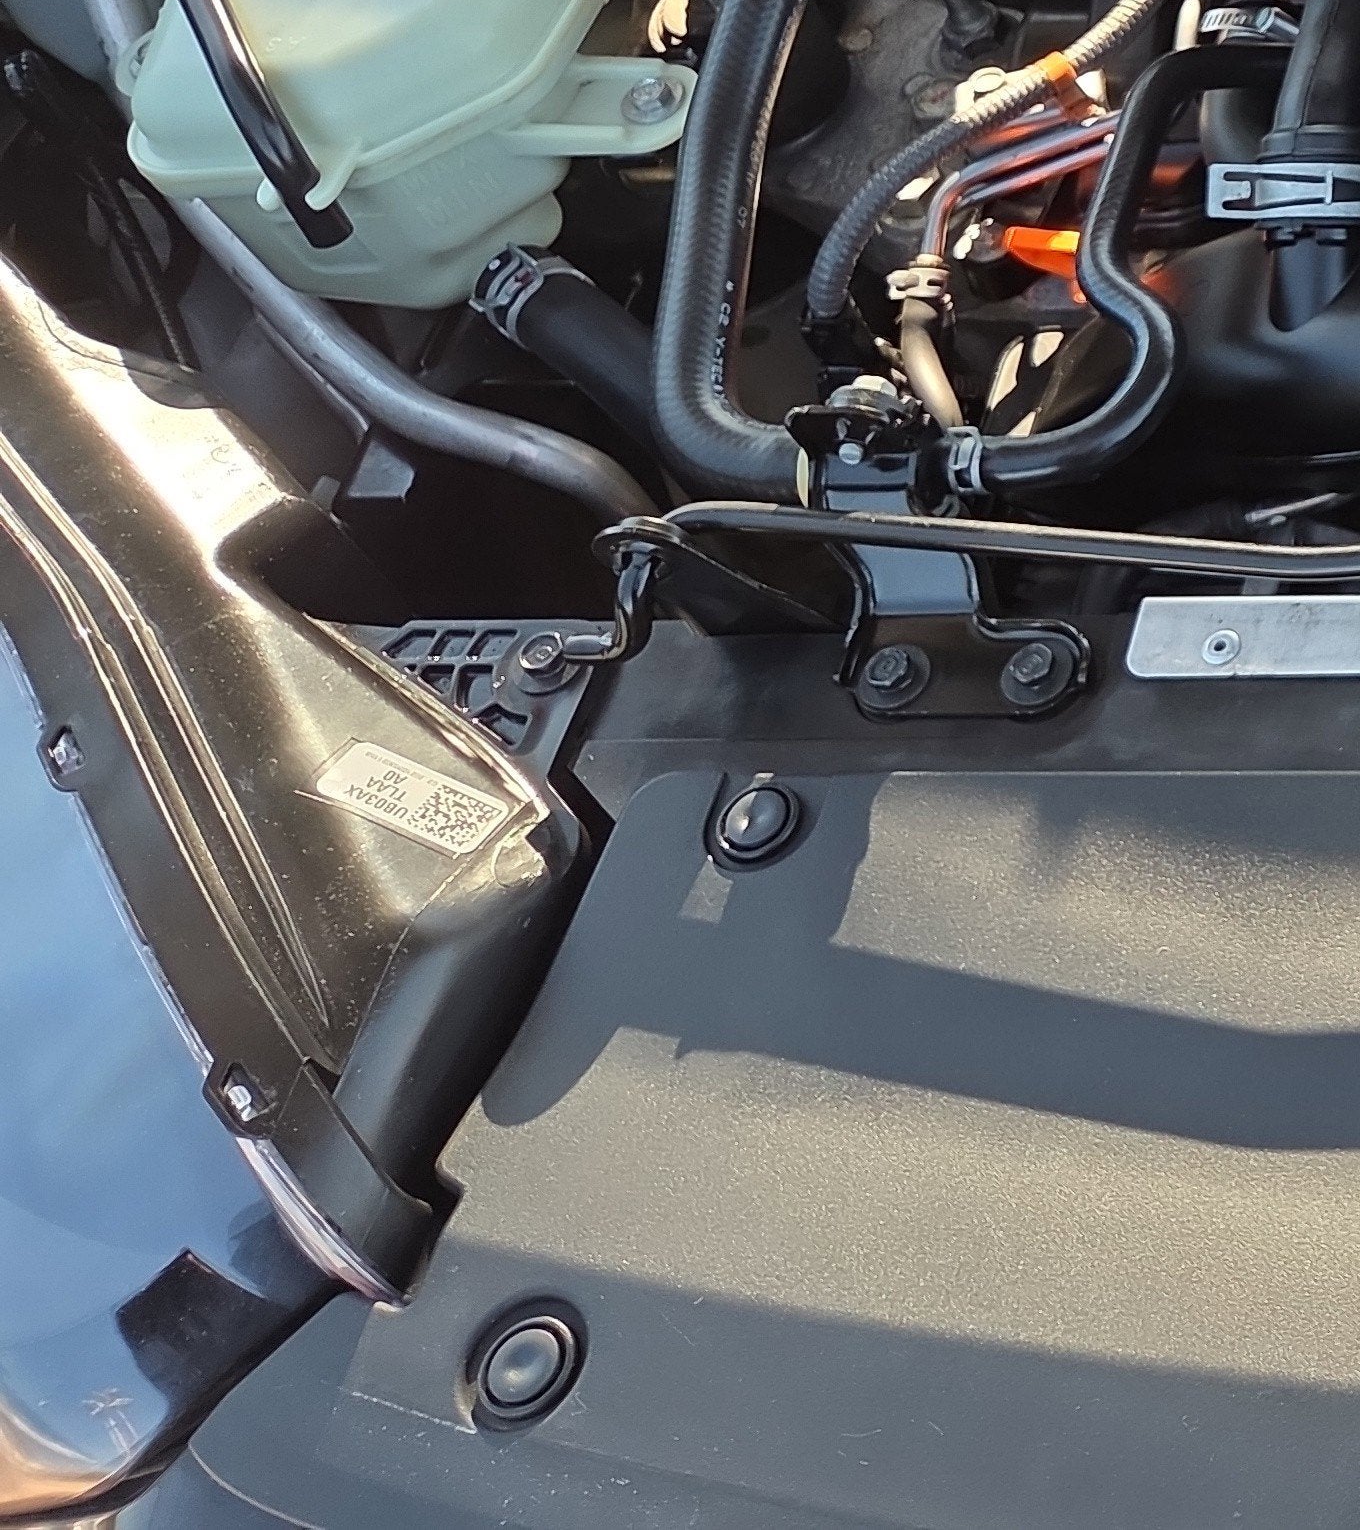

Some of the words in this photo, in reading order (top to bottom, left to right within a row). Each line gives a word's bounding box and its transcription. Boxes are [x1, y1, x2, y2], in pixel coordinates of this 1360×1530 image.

[366, 776, 407, 802] TLAA
[383, 770, 408, 784] A0
[343, 784, 408, 819] UB03AX
